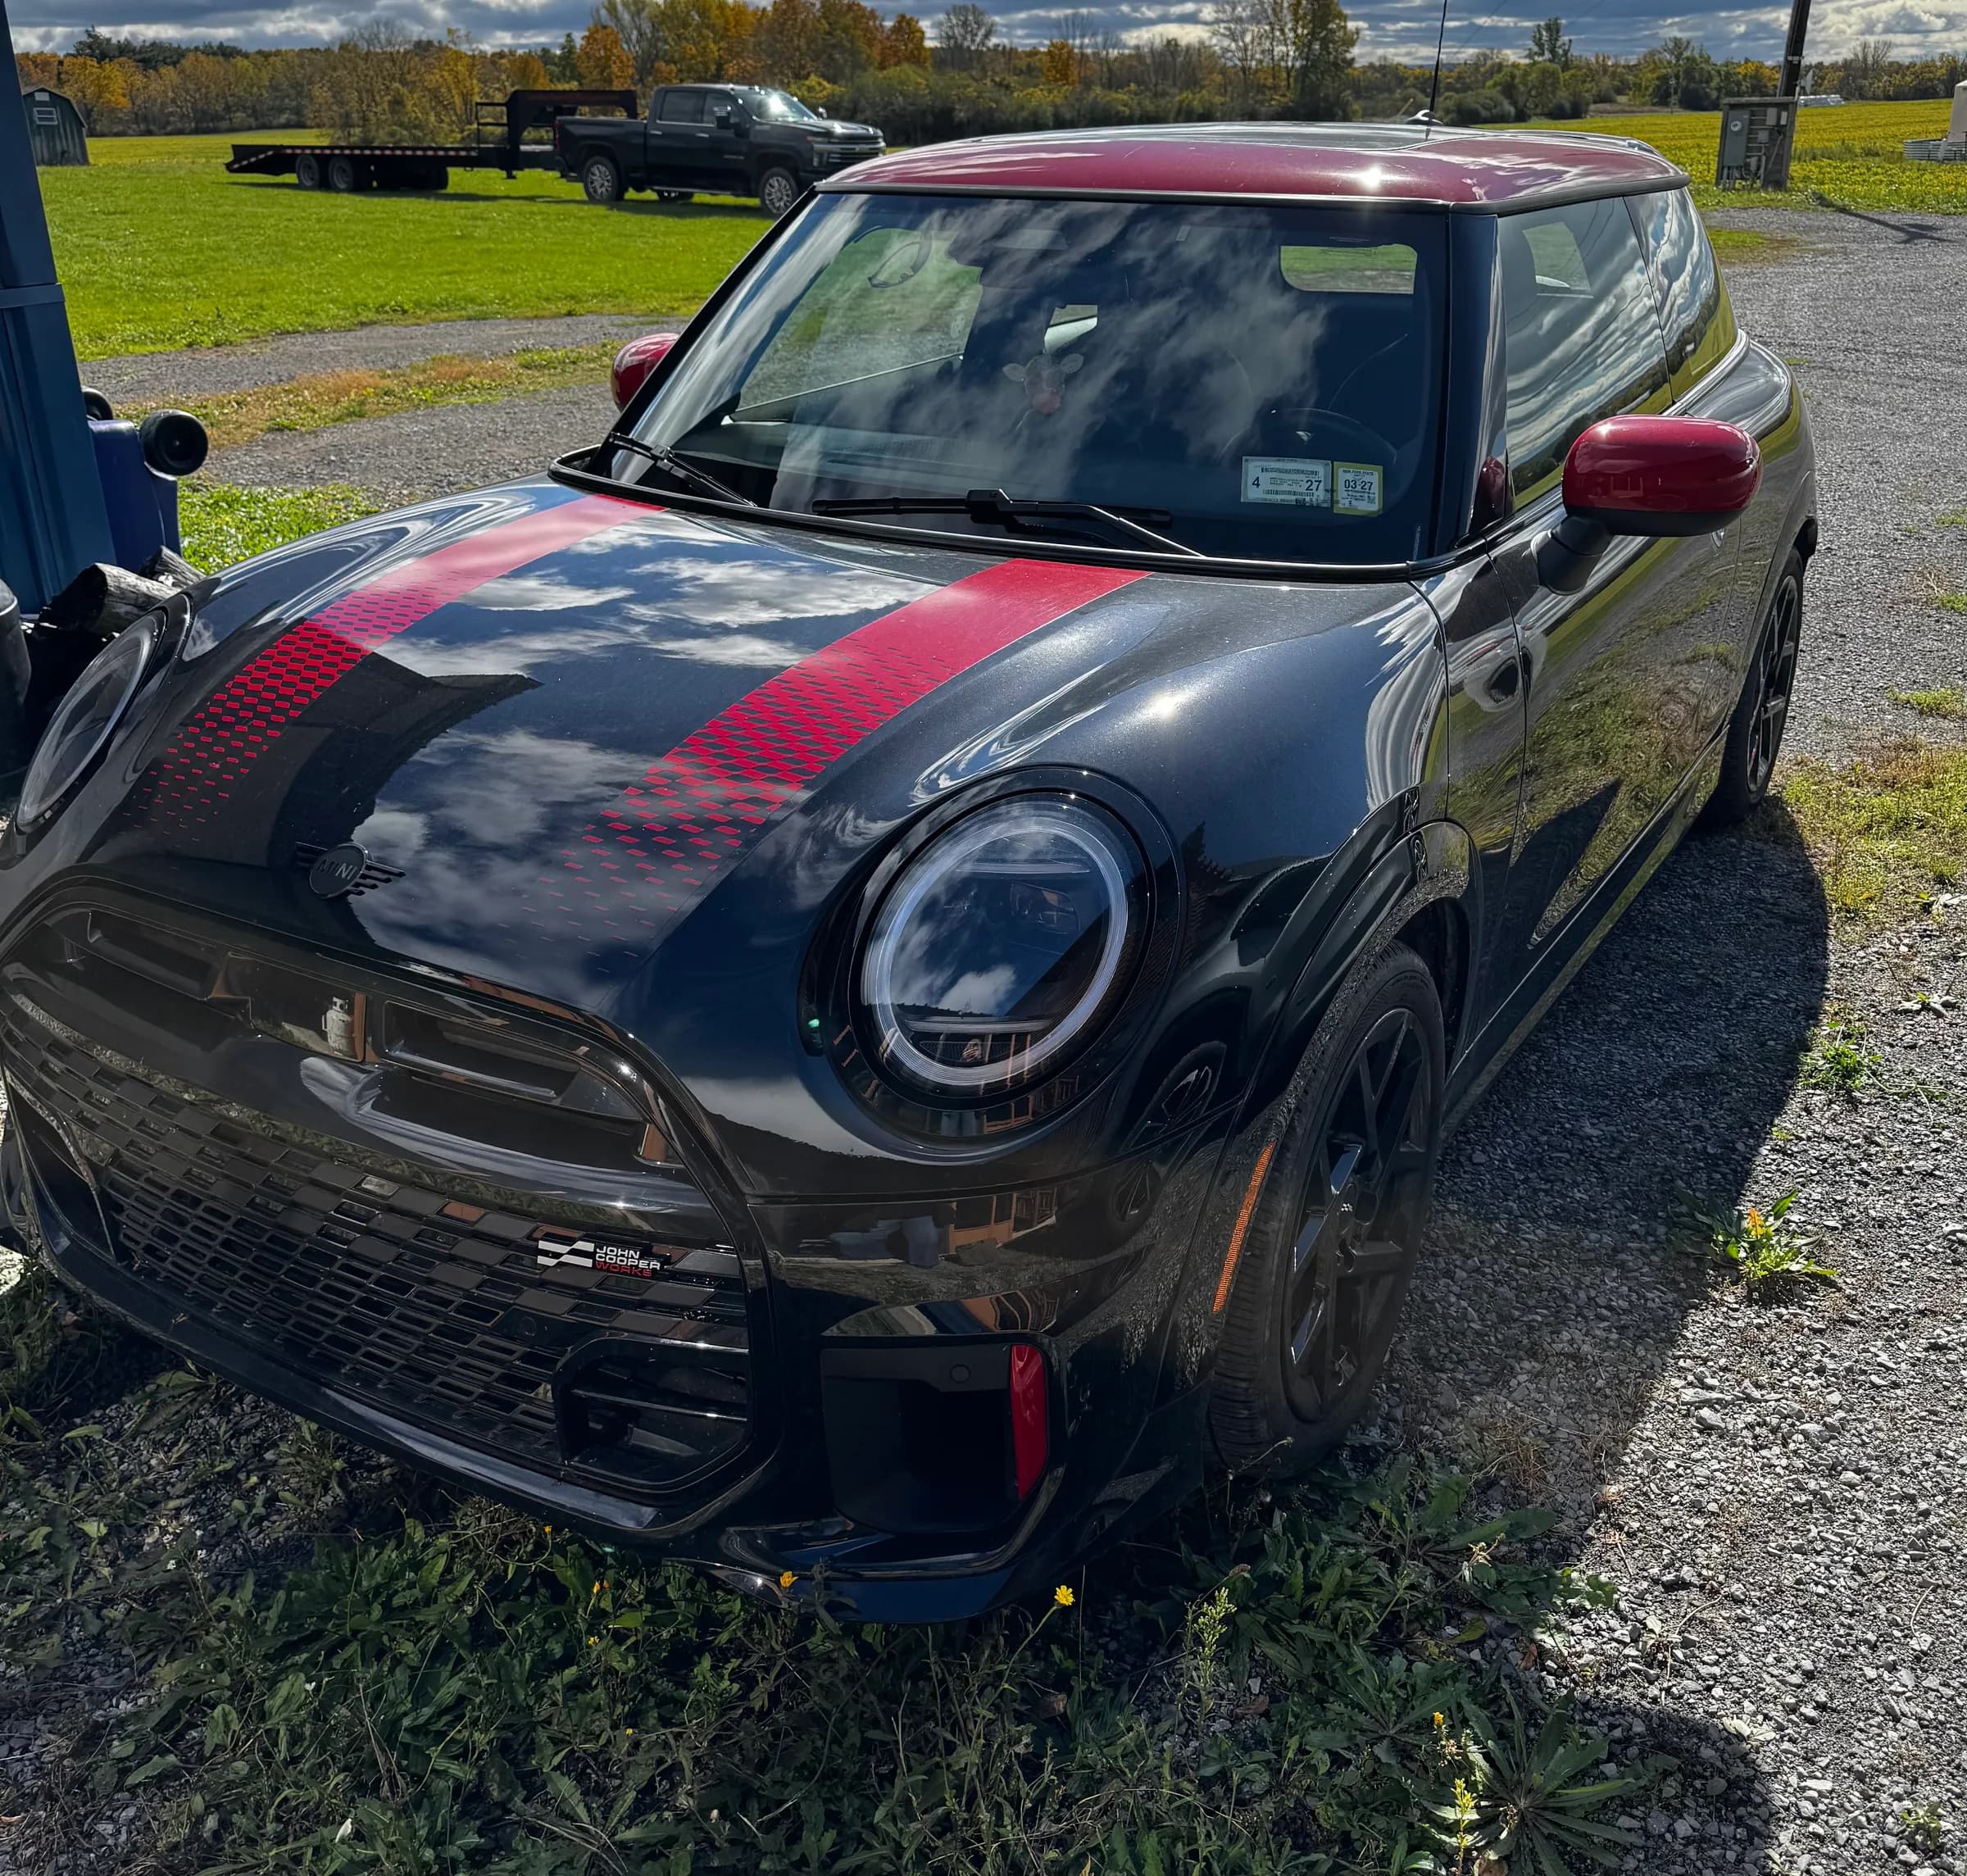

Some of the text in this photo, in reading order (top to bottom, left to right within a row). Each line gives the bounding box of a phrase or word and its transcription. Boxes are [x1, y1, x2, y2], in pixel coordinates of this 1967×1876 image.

[1252, 476, 1261, 488] 4
[1306, 479, 1322, 492] 27
[320, 859, 357, 879] MINI
[597, 1246, 639, 1258] JOHN
[596, 1253, 661, 1270] COOPER
[596, 1262, 652, 1277] WORKS
